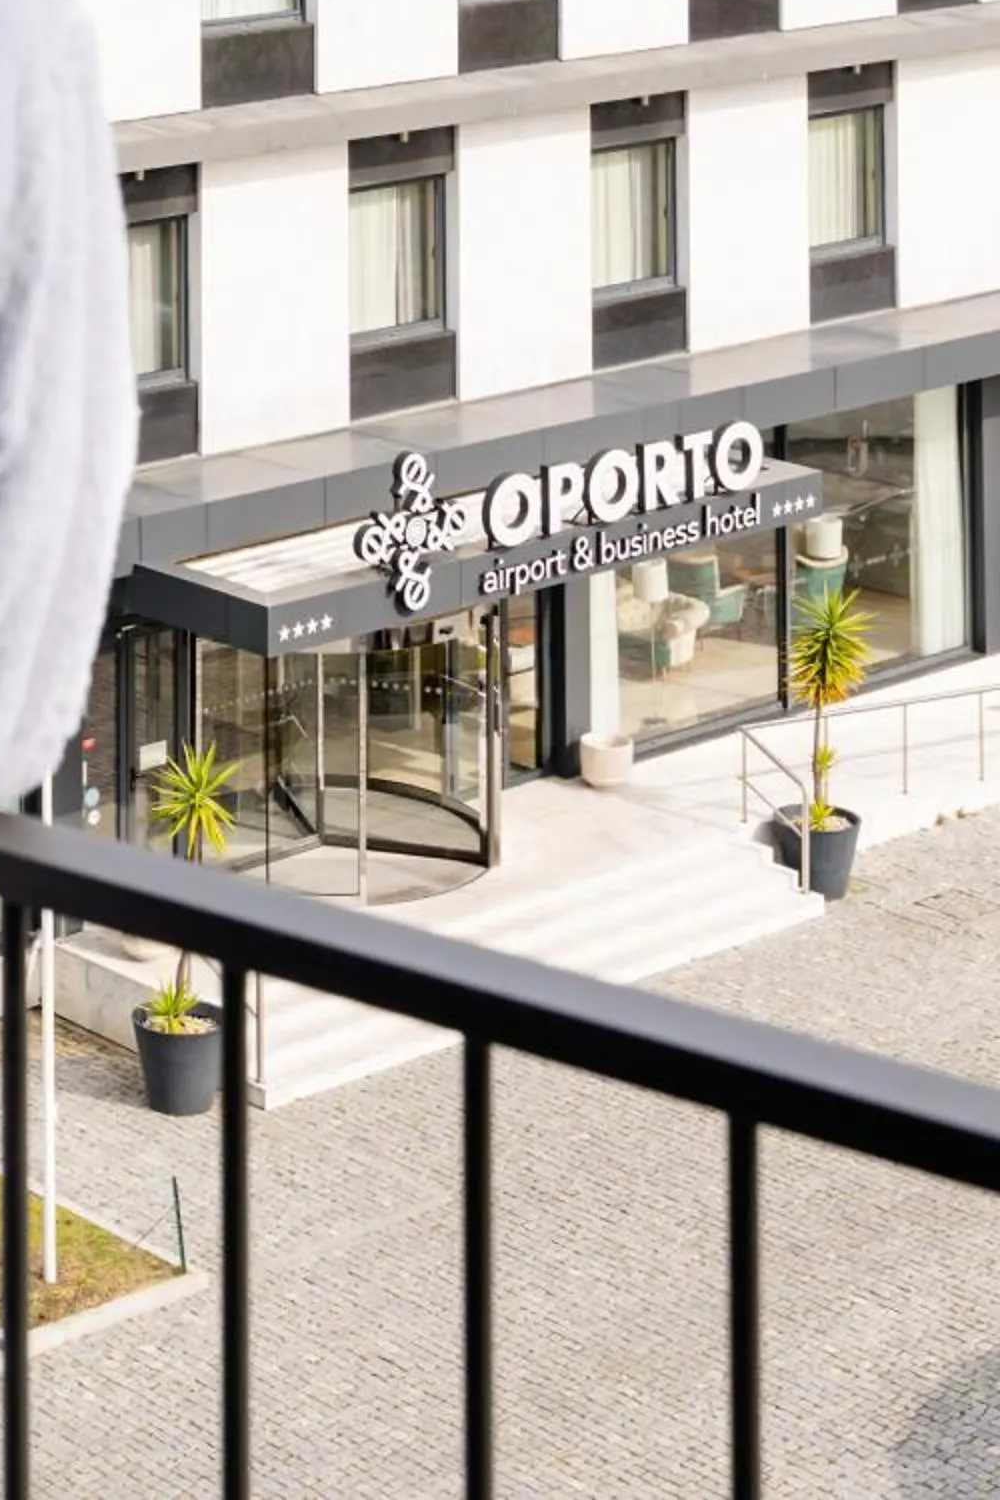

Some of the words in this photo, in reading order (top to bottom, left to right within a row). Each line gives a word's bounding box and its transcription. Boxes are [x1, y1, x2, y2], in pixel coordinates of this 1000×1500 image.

[487, 420, 764, 547] OPORTO
[483, 555, 567, 595] airport
[573, 536, 595, 572] &
[601, 518, 701, 565] business
[705, 492, 762, 539] hotel
